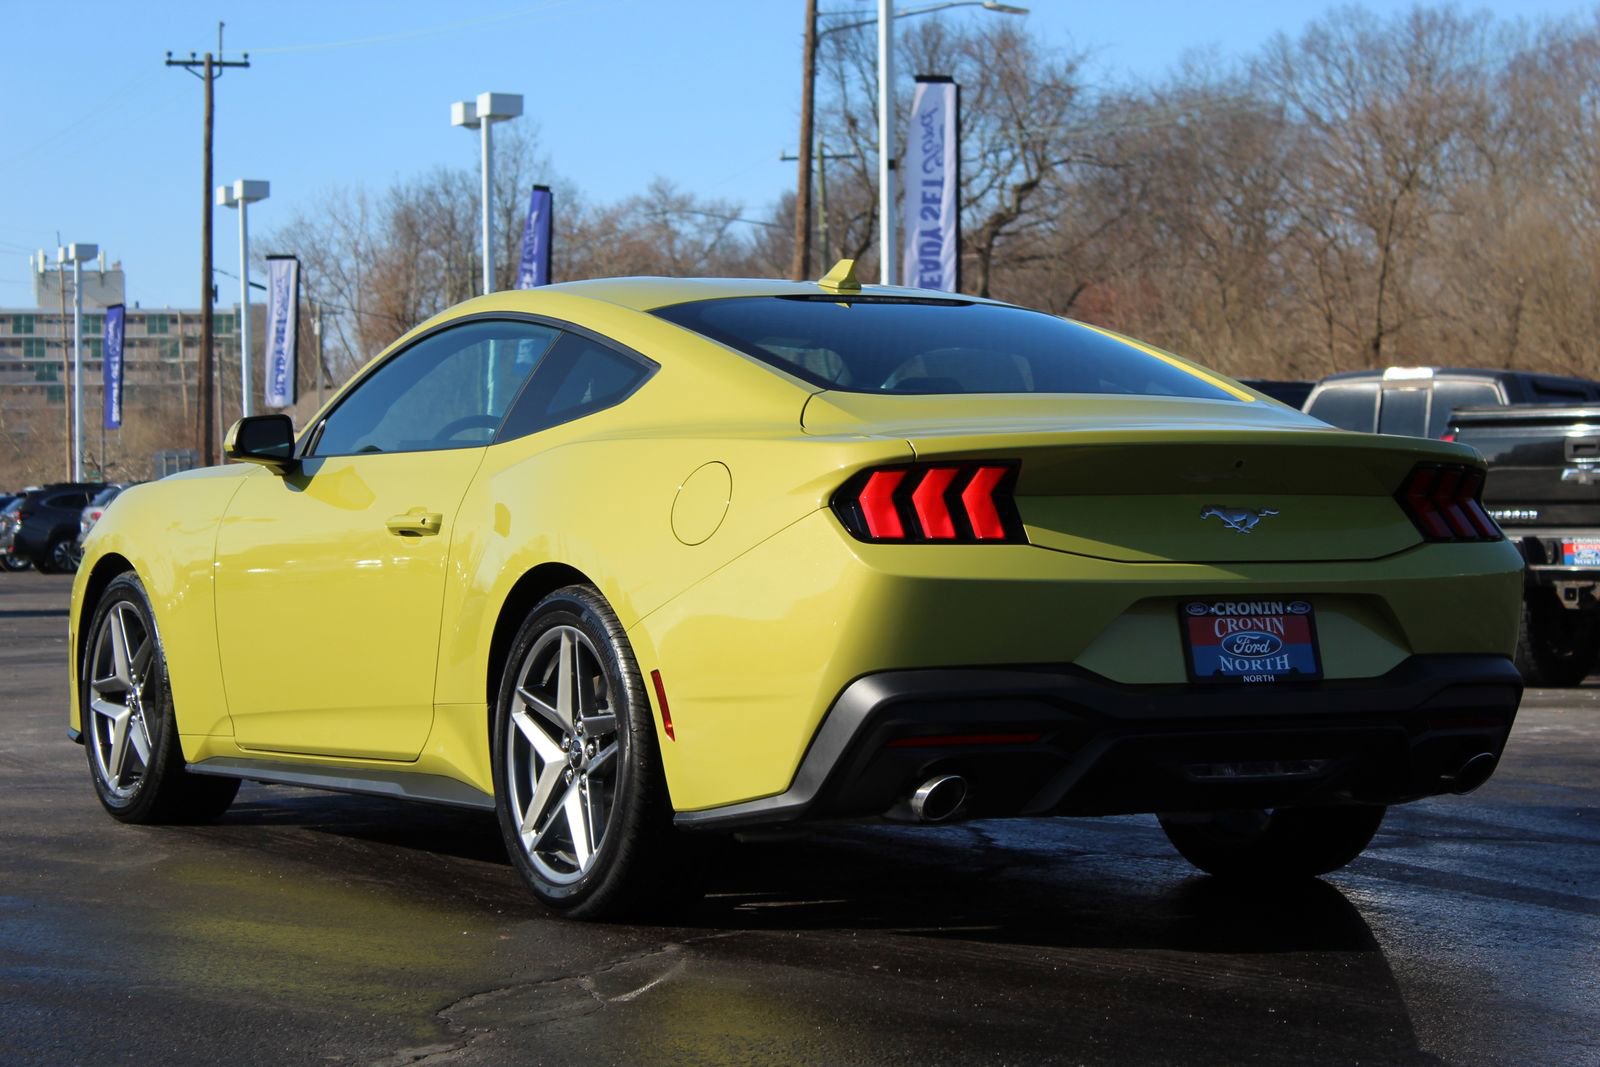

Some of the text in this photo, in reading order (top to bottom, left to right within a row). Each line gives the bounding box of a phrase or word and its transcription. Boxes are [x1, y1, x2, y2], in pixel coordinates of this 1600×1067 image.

[1213, 601, 1284, 615] CRONIN
[1214, 617, 1285, 638] CRONIN
[1233, 634, 1271, 653] Ford
[1219, 653, 1291, 671] NORTH
[1243, 674, 1275, 682] NORTH
